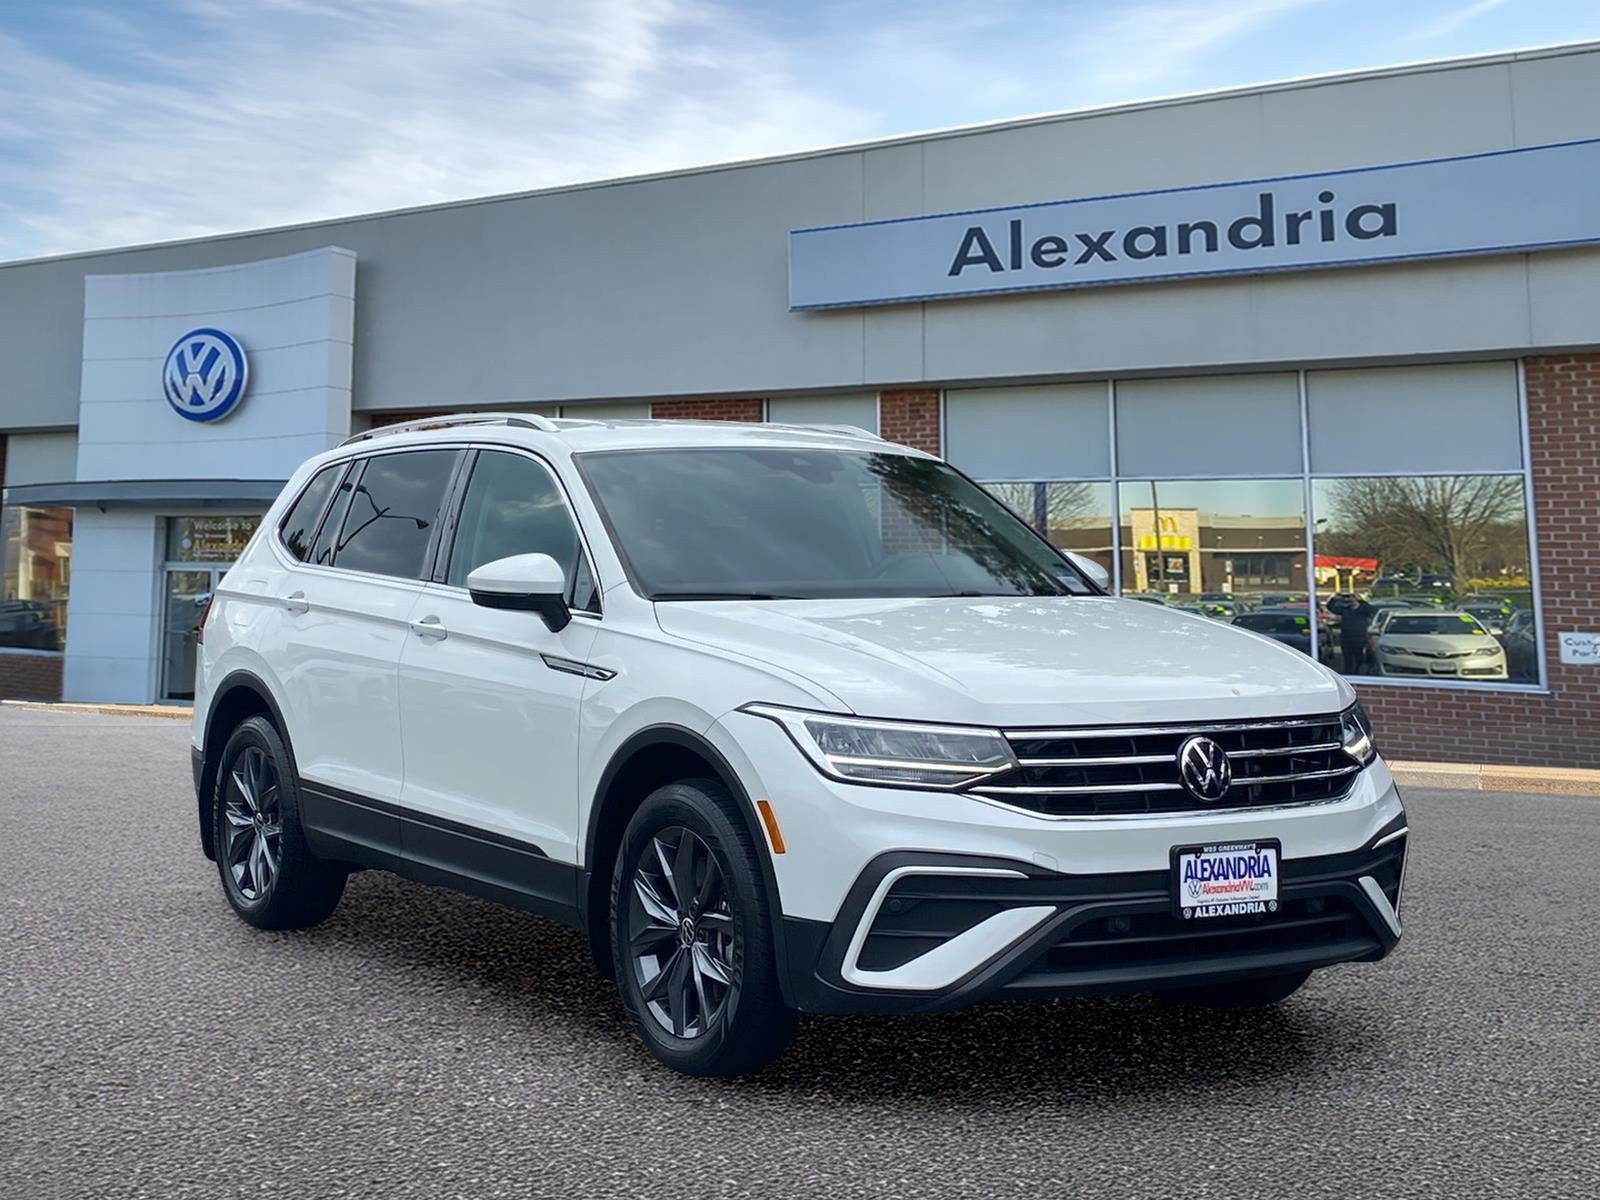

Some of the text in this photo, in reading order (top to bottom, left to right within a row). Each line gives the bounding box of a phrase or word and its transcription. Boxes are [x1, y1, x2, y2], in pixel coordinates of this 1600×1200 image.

[947, 190, 1398, 277] Alexandria
[1184, 855, 1272, 883] ALEXANDRIA
[1194, 901, 1267, 918] ALEXANDRIA
